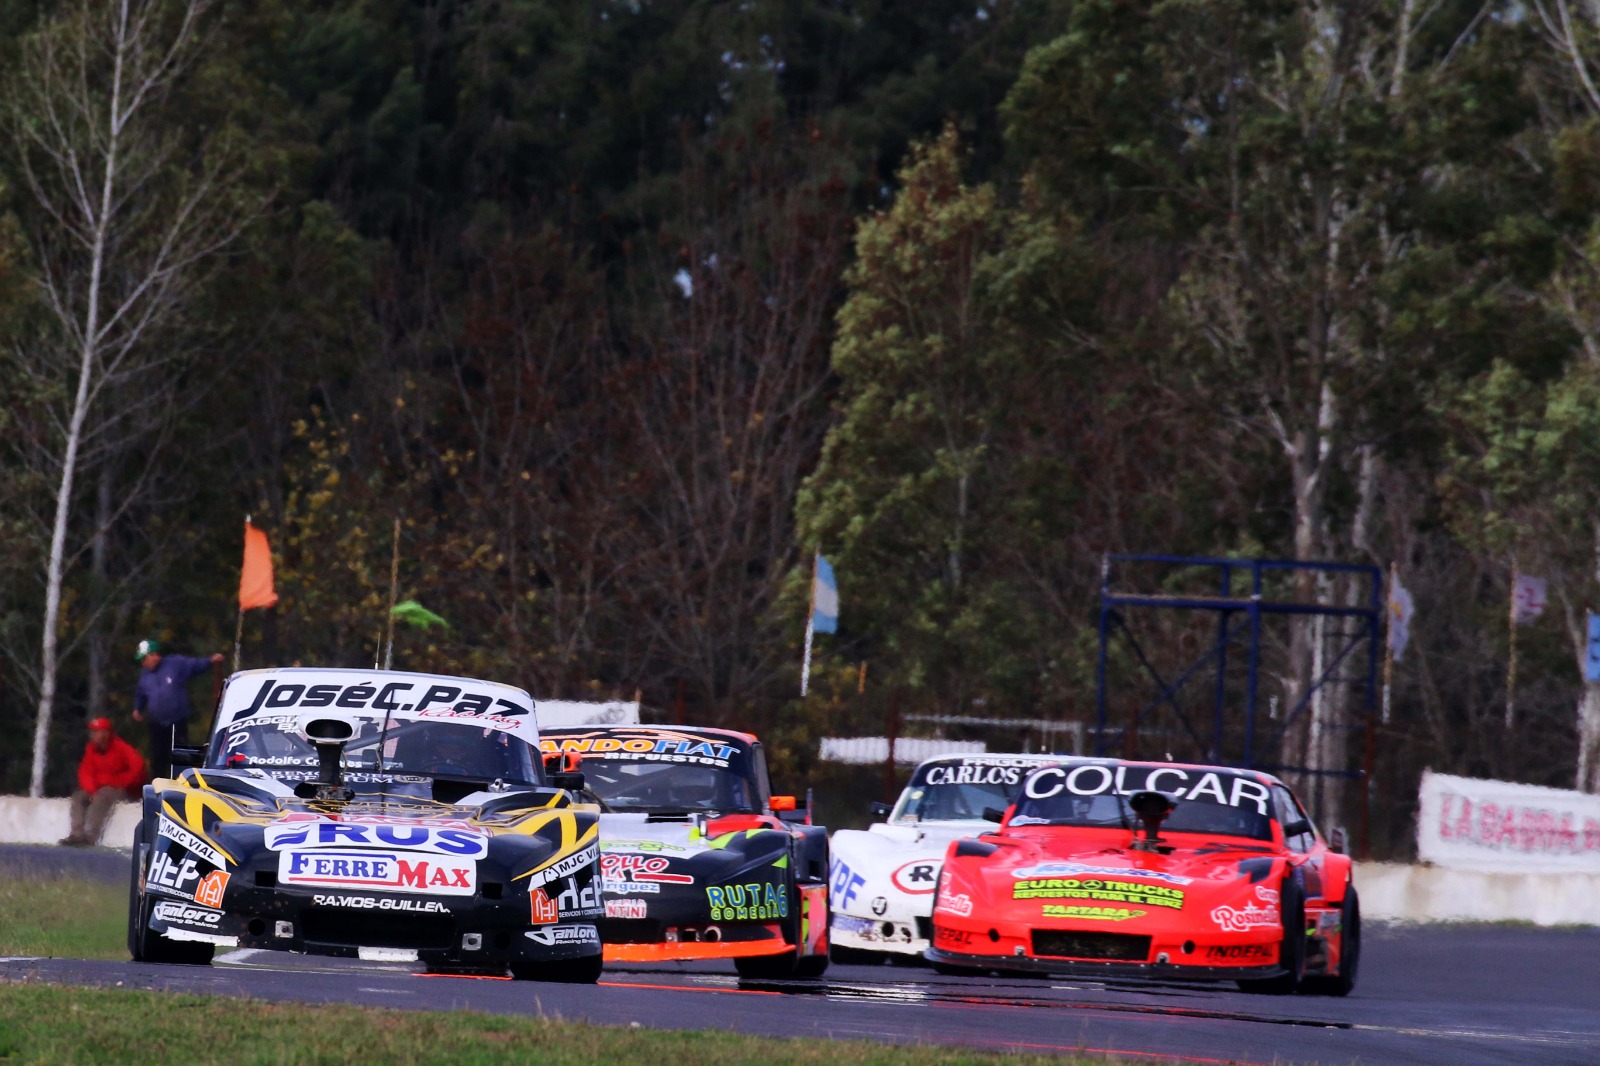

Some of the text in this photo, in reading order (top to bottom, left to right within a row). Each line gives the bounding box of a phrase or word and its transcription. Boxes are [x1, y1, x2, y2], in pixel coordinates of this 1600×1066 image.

[249, 756, 301, 766] Rodolfo
[604, 752, 729, 768] REPUESTOS
[271, 776, 394, 784] PREIUM
[926, 766, 1021, 785] CARLOS
[1025, 765, 1271, 816] COLCAR
[165, 825, 215, 860] MJC VIAL
[319, 824, 483, 854] RUS
[148, 850, 200, 889] HEP
[560, 854, 585, 873] MJC
[600, 854, 669, 873] OLLO
[706, 882, 777, 909] RUTA
[1014, 879, 1184, 899] EURO TRUCKS
[1013, 889, 1090, 899] REPUESTOS
[1092, 891, 1126, 902] PARA
[1147, 897, 1183, 909] BENZ
[711, 906, 780, 920] GOMERIA
